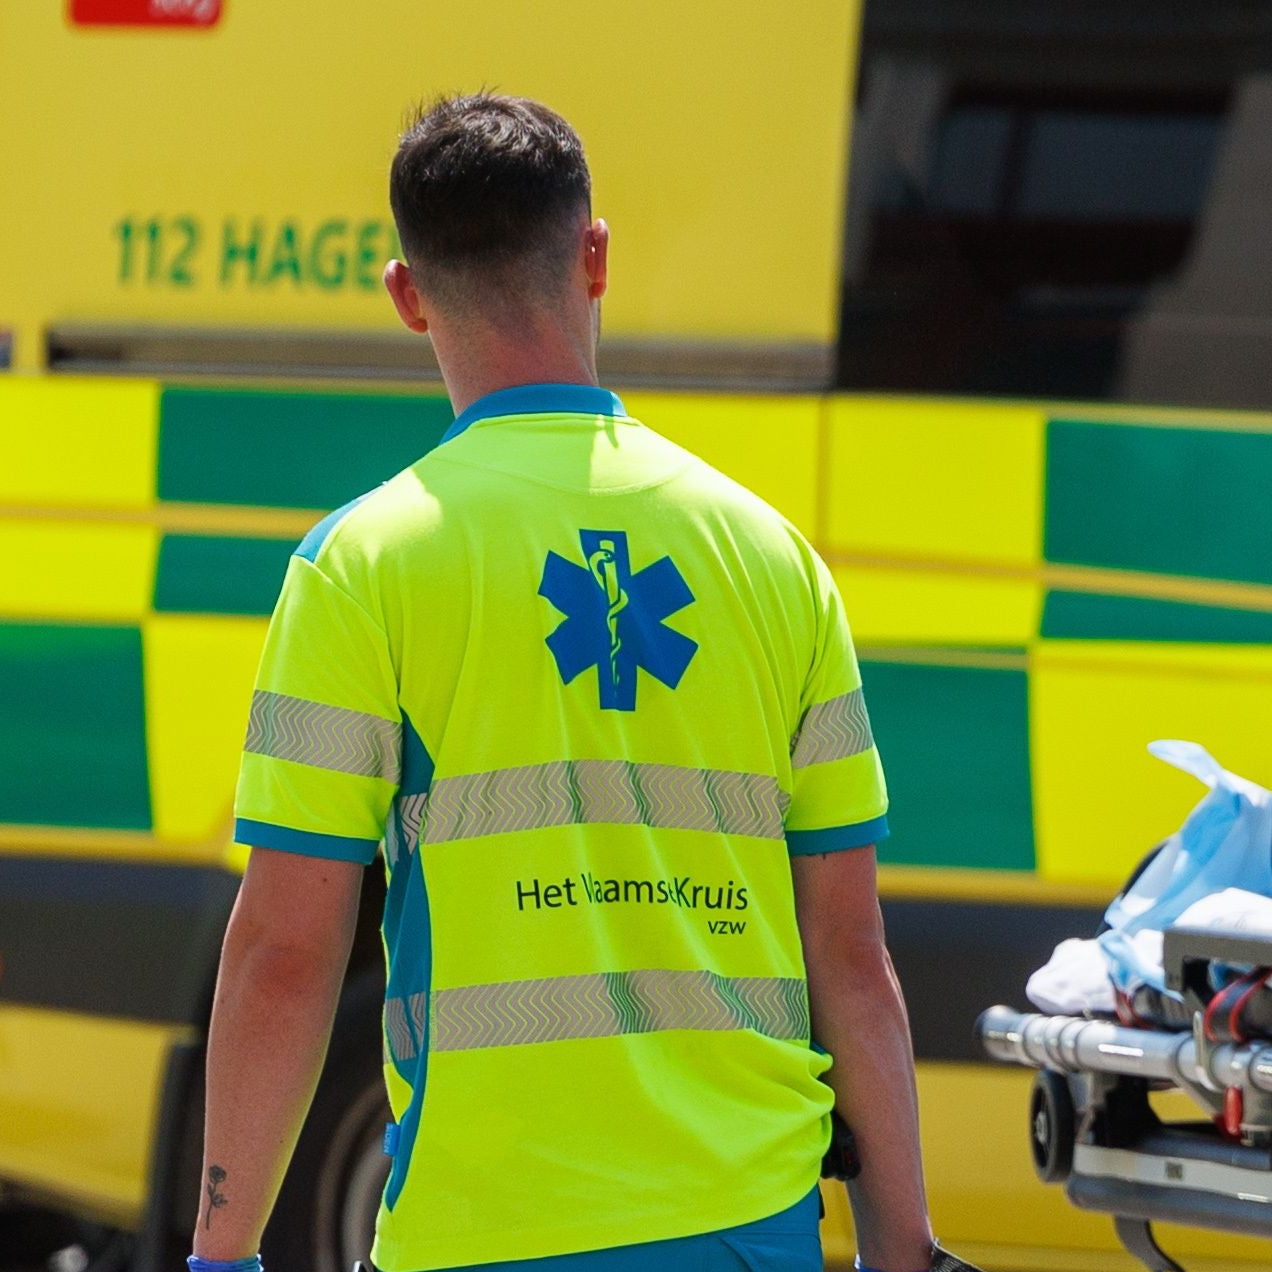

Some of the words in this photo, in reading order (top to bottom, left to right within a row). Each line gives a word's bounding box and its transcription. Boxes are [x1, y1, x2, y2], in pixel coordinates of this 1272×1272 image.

[116, 216, 197, 287] 112
[219, 217, 406, 289] HAGE
[516, 877, 578, 911] Het
[674, 876, 749, 911] Kruis
[708, 920, 747, 935] vzw
